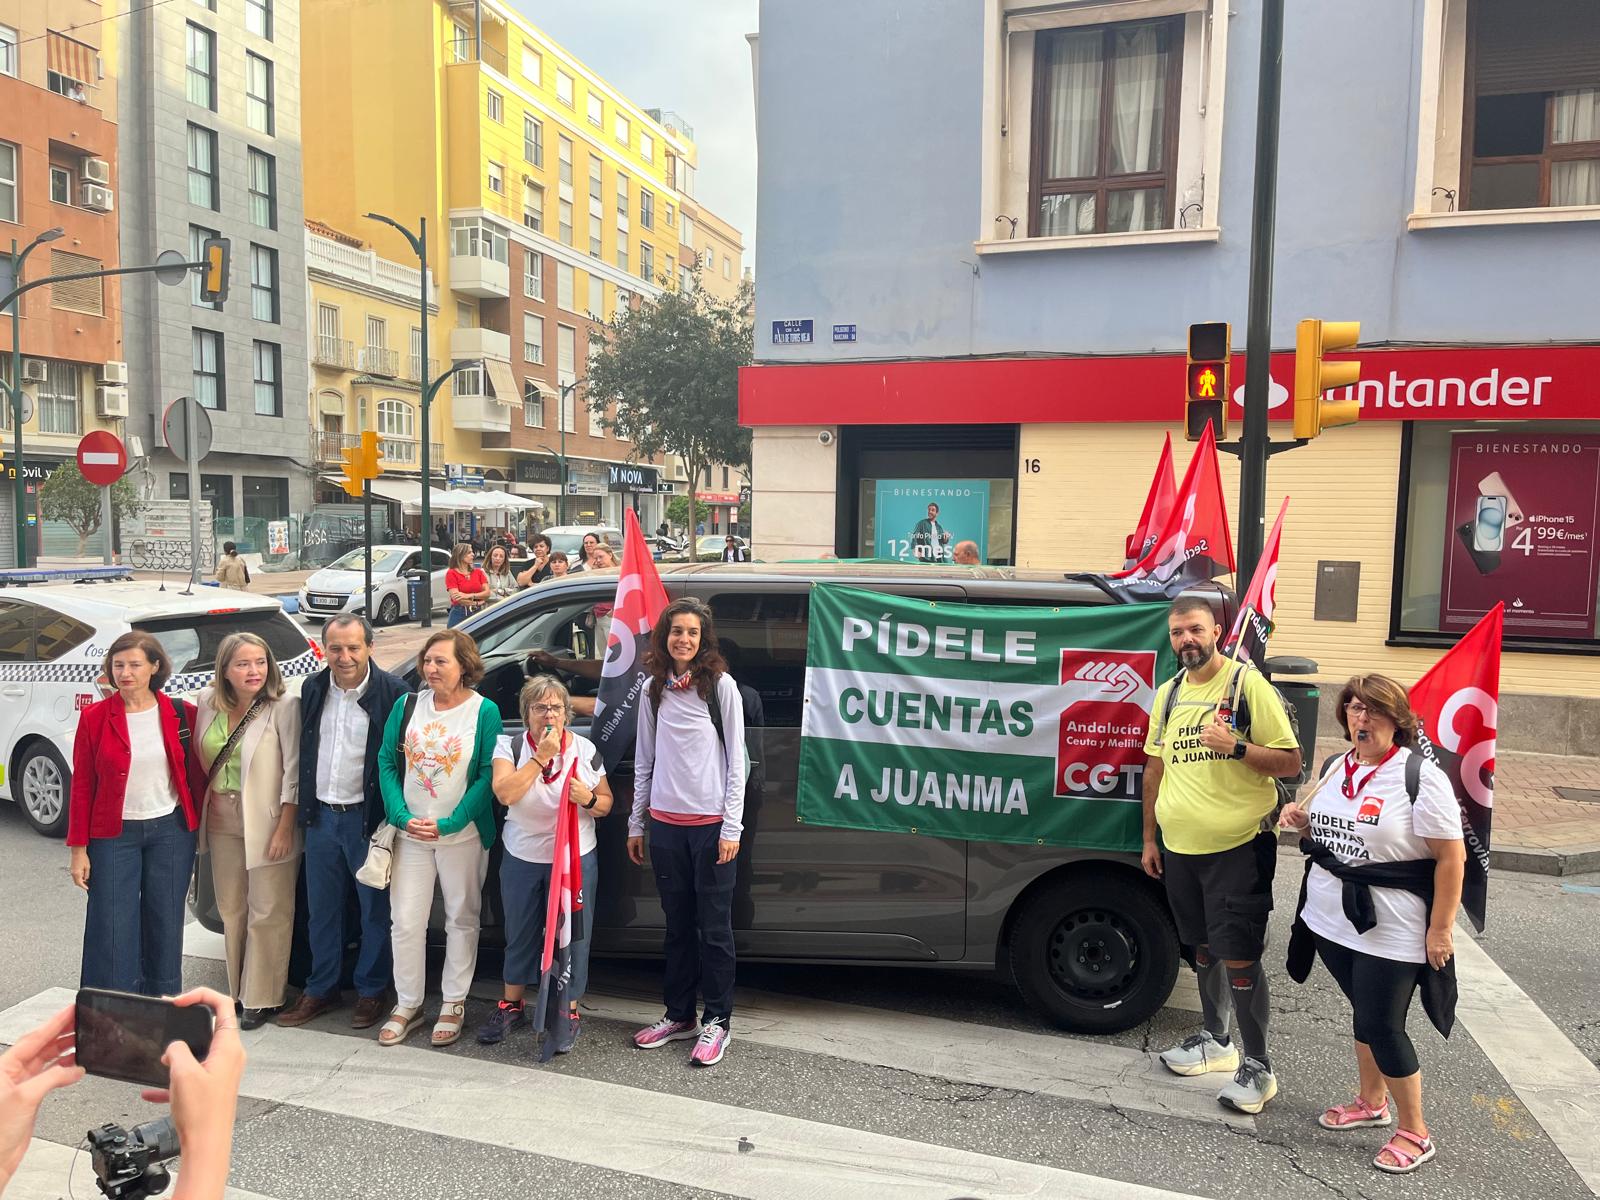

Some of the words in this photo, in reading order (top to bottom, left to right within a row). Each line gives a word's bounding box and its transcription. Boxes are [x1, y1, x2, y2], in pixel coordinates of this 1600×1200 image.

[1475, 443, 1583, 455] BIENESTANDO
[22, 466, 43, 478] óvil
[1024, 458, 1041, 474] 16
[620, 469, 643, 485] NOVA
[893, 487, 972, 498] BIENESTANDO
[1535, 515, 1564, 523] iPhone
[1566, 515, 1575, 523] 15
[887, 539, 910, 557] 12
[914, 541, 953, 559] mes
[841, 612, 1037, 665] PÍDELE
[838, 686, 1034, 738] CUENTAS
[1178, 725, 1204, 737] PÍDE
[1066, 736, 1096, 748] Ceuta
[1099, 739, 1106, 750] y
[1108, 737, 1144, 749] Melilla
[1172, 738, 1203, 751] CUEN
[1171, 754, 1179, 765] A
[1063, 761, 1144, 796] CGT
[833, 763, 859, 801] A
[870, 766, 1030, 816] JUANMA
[1310, 811, 1355, 832] PÍDELE
[1358, 813, 1378, 823] CGT
[1311, 827, 1365, 847] UENTAS
